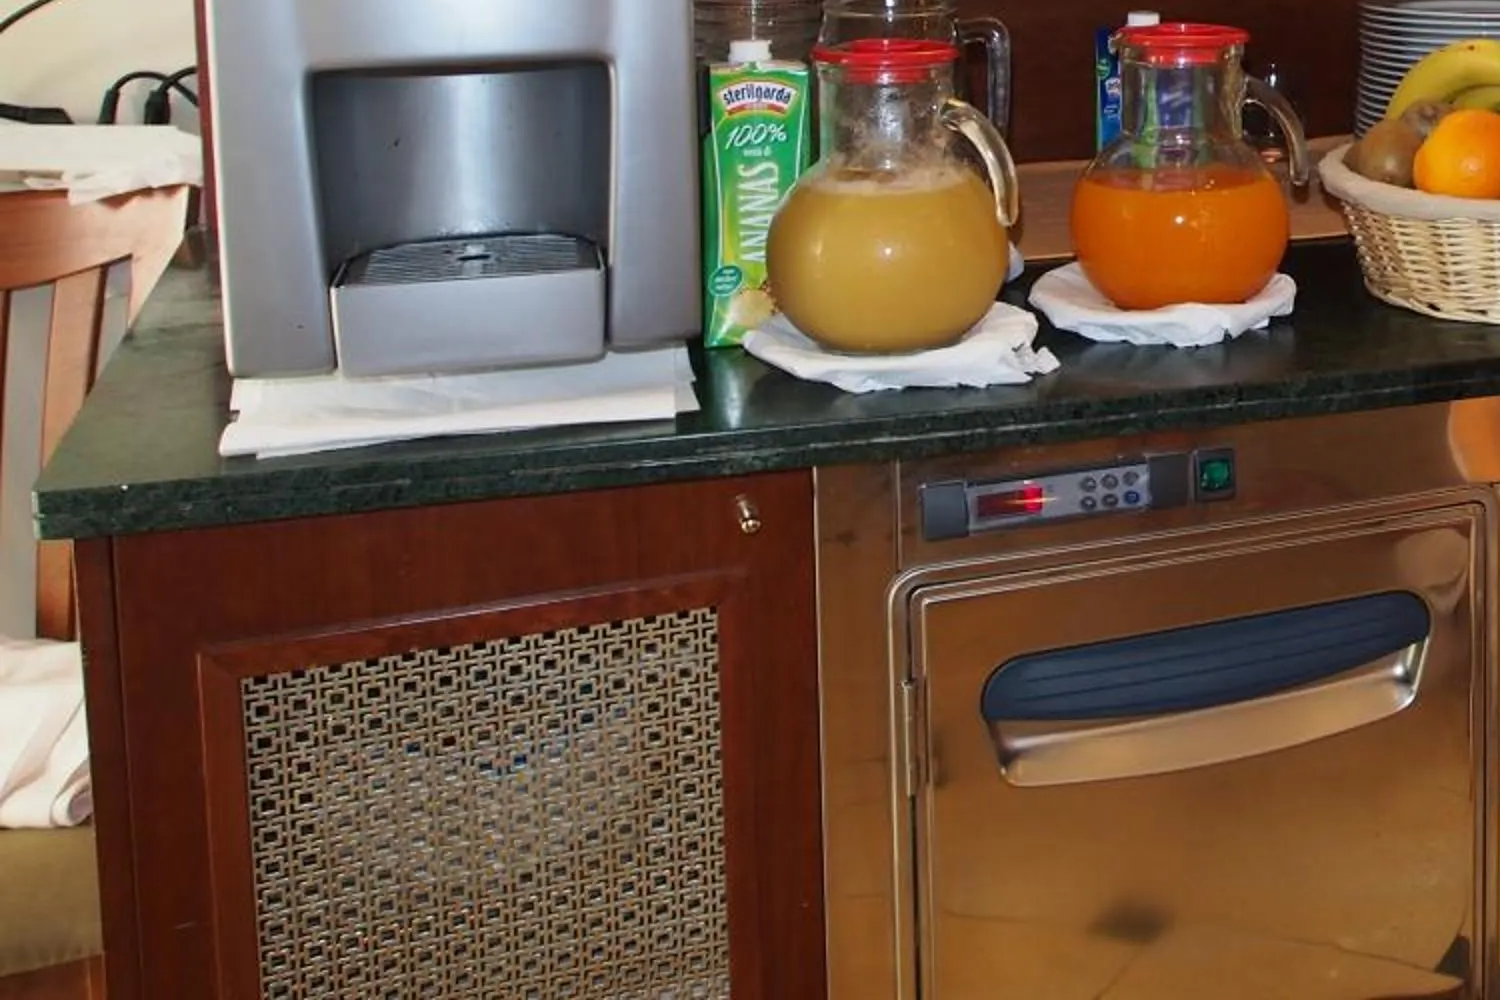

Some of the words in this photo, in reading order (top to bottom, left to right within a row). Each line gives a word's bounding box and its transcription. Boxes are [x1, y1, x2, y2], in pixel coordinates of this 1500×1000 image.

[723, 83, 792, 105] sterilgarda
[725, 123, 787, 150] 100%
[737, 161, 779, 262] ANANAS
